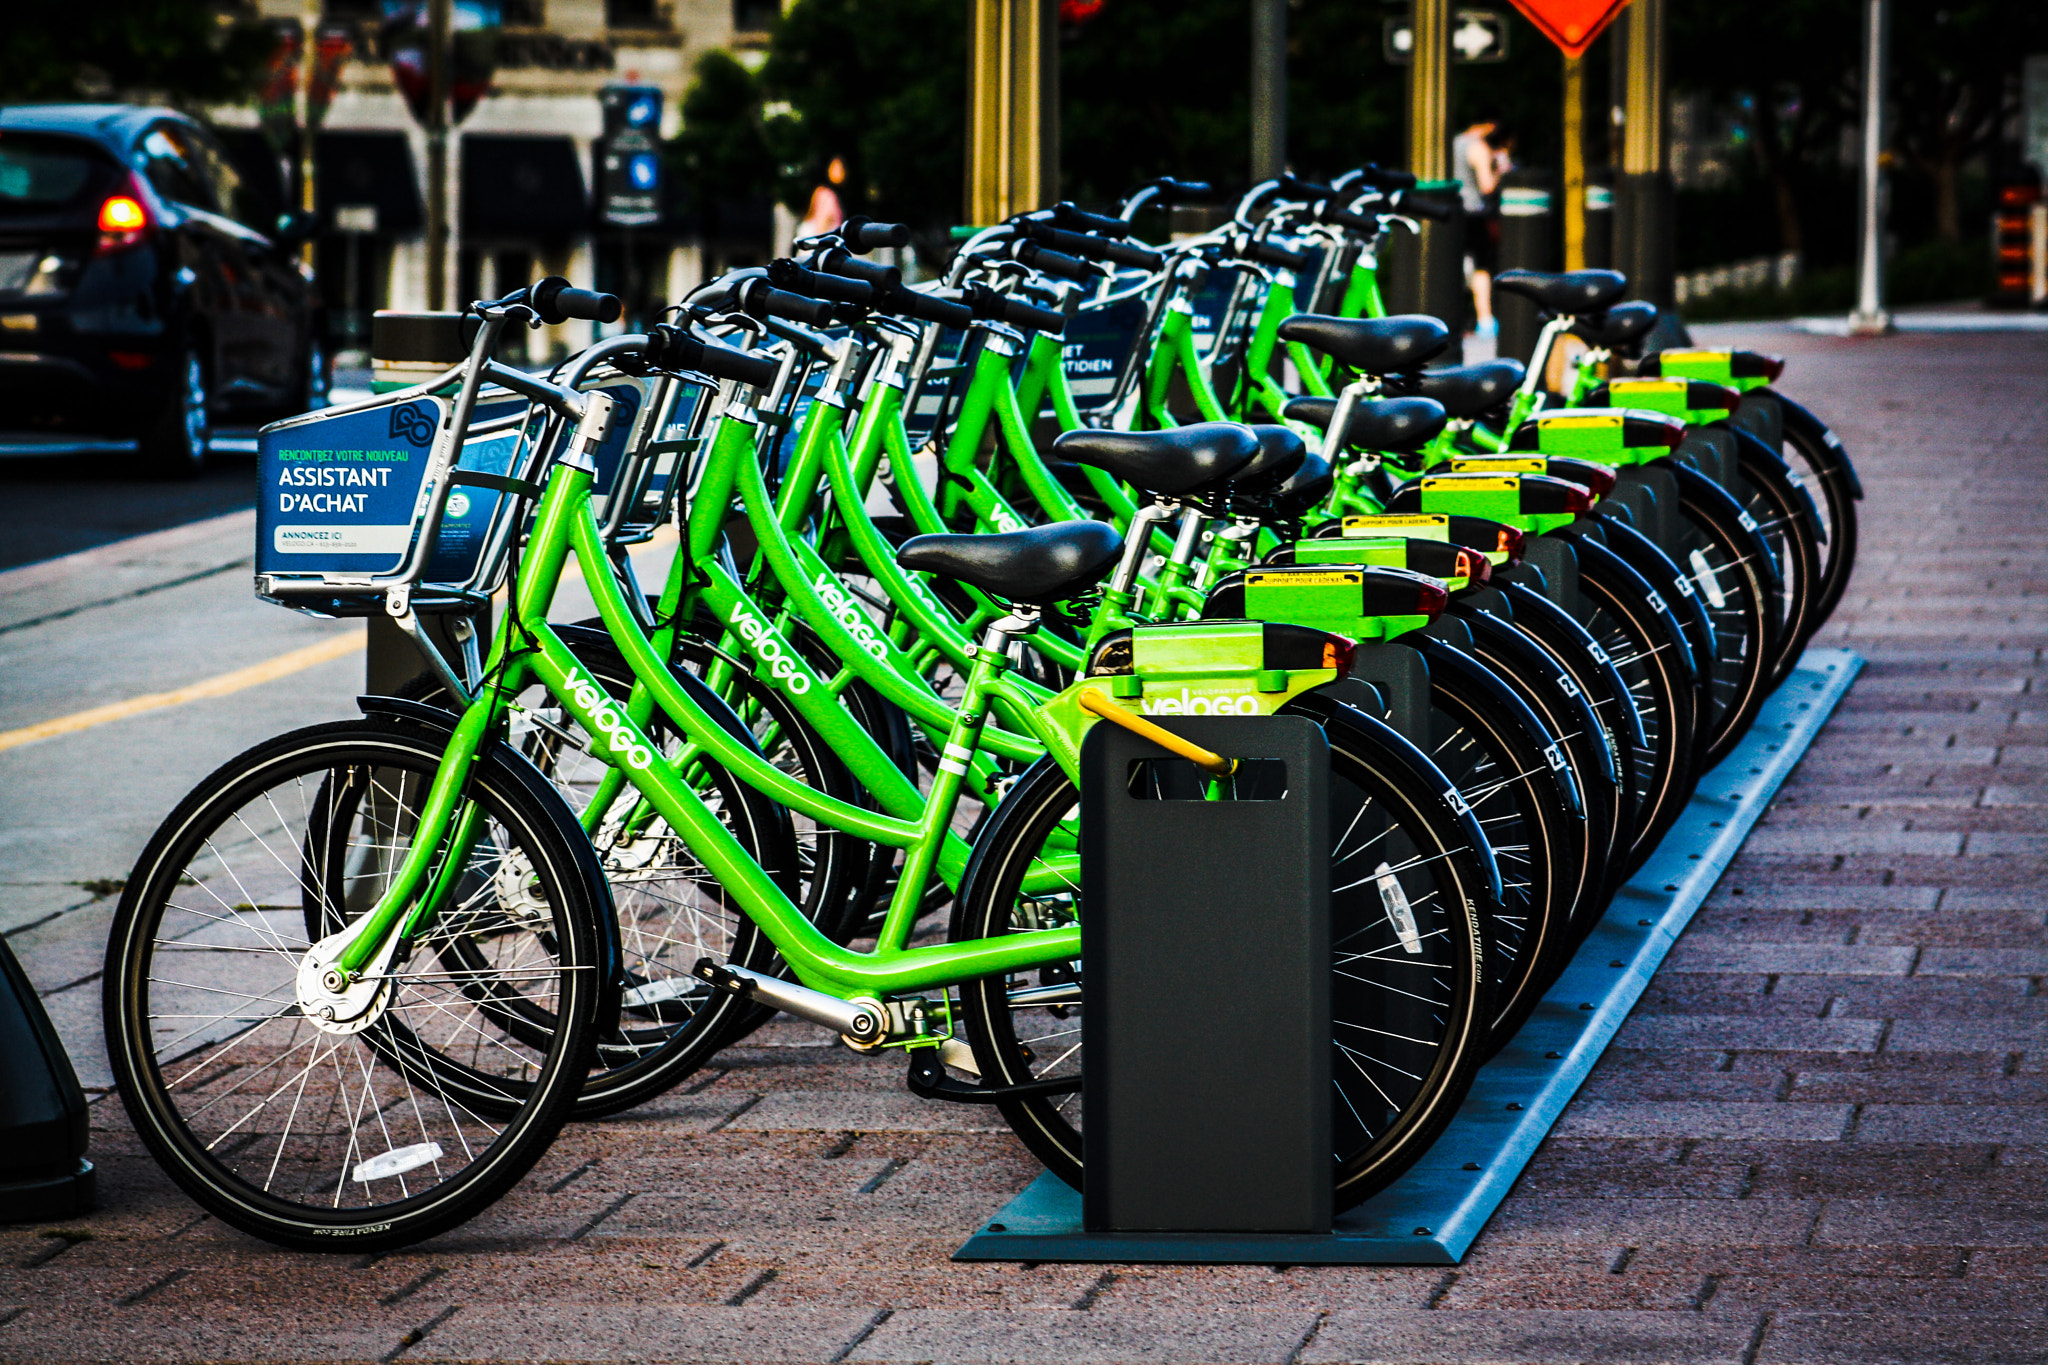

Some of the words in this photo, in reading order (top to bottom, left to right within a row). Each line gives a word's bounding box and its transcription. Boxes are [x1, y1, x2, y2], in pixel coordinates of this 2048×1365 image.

[1063, 359, 1113, 373] TIDIEN
[278, 449, 334, 462] RENCONTREZ
[335, 450, 364, 462] VOTRE
[366, 450, 409, 462] NOUVEAU
[278, 466, 393, 487] ASSISTANT
[279, 492, 369, 513] D'ACHAT
[281, 531, 330, 540] ANNONCEZ
[330, 531, 343, 540] ICI
